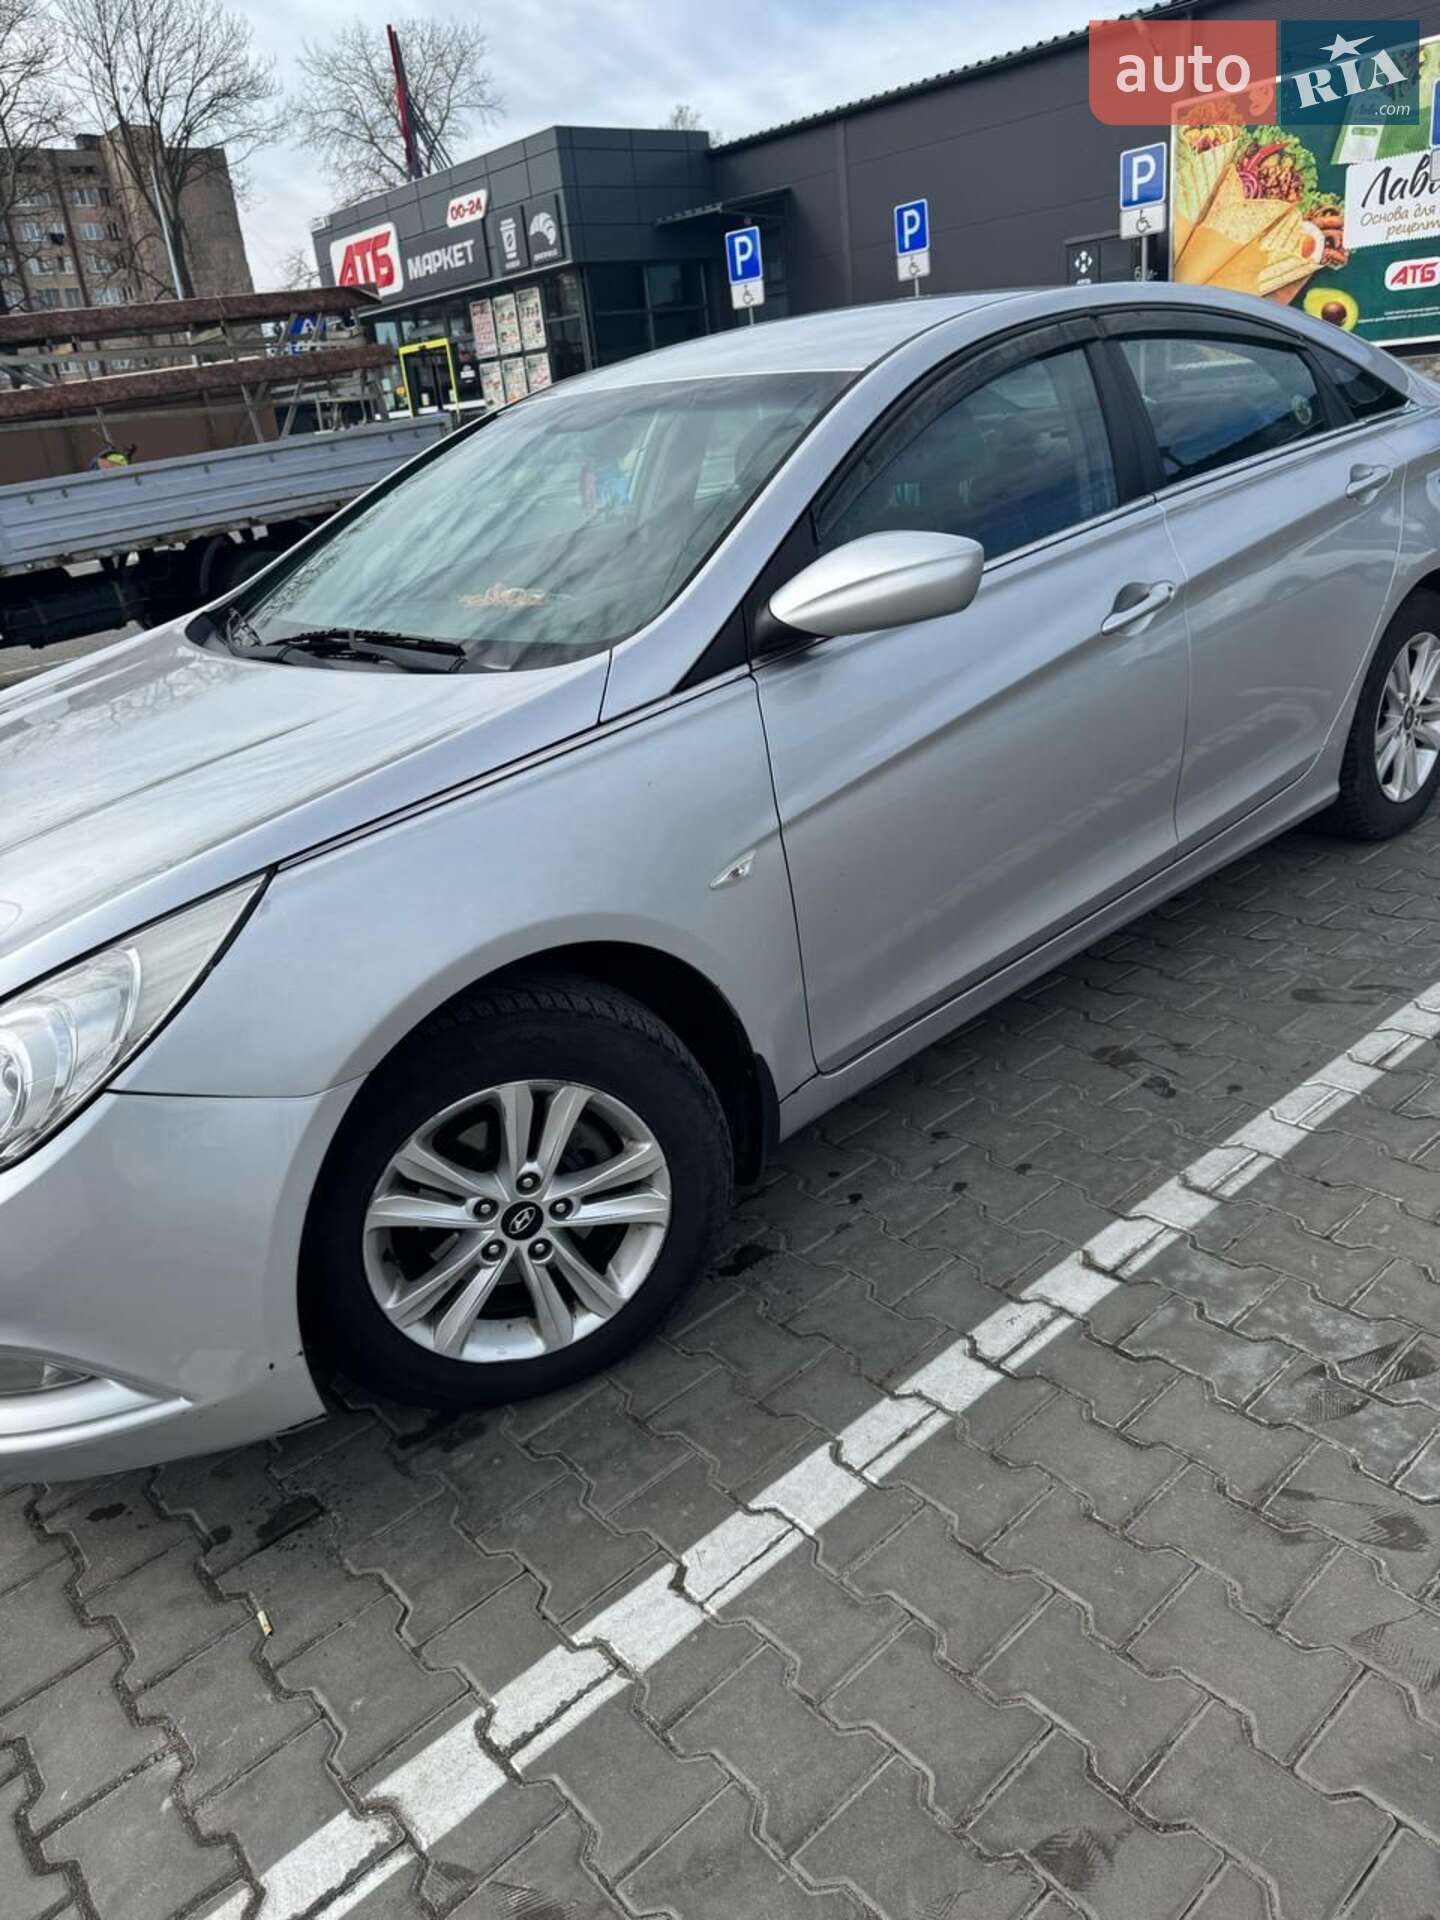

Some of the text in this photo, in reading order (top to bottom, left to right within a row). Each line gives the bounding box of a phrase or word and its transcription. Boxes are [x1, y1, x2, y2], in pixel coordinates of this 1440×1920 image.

[1131, 153, 1156, 202] P
[450, 197, 482, 221] 00-24
[903, 209, 920, 249] P
[1360, 205, 1409, 227] Основа
[339, 231, 475, 289] АТБ МАРКЕТ
[734, 235, 753, 276] P
[1390, 261, 1440, 287] АТБ
